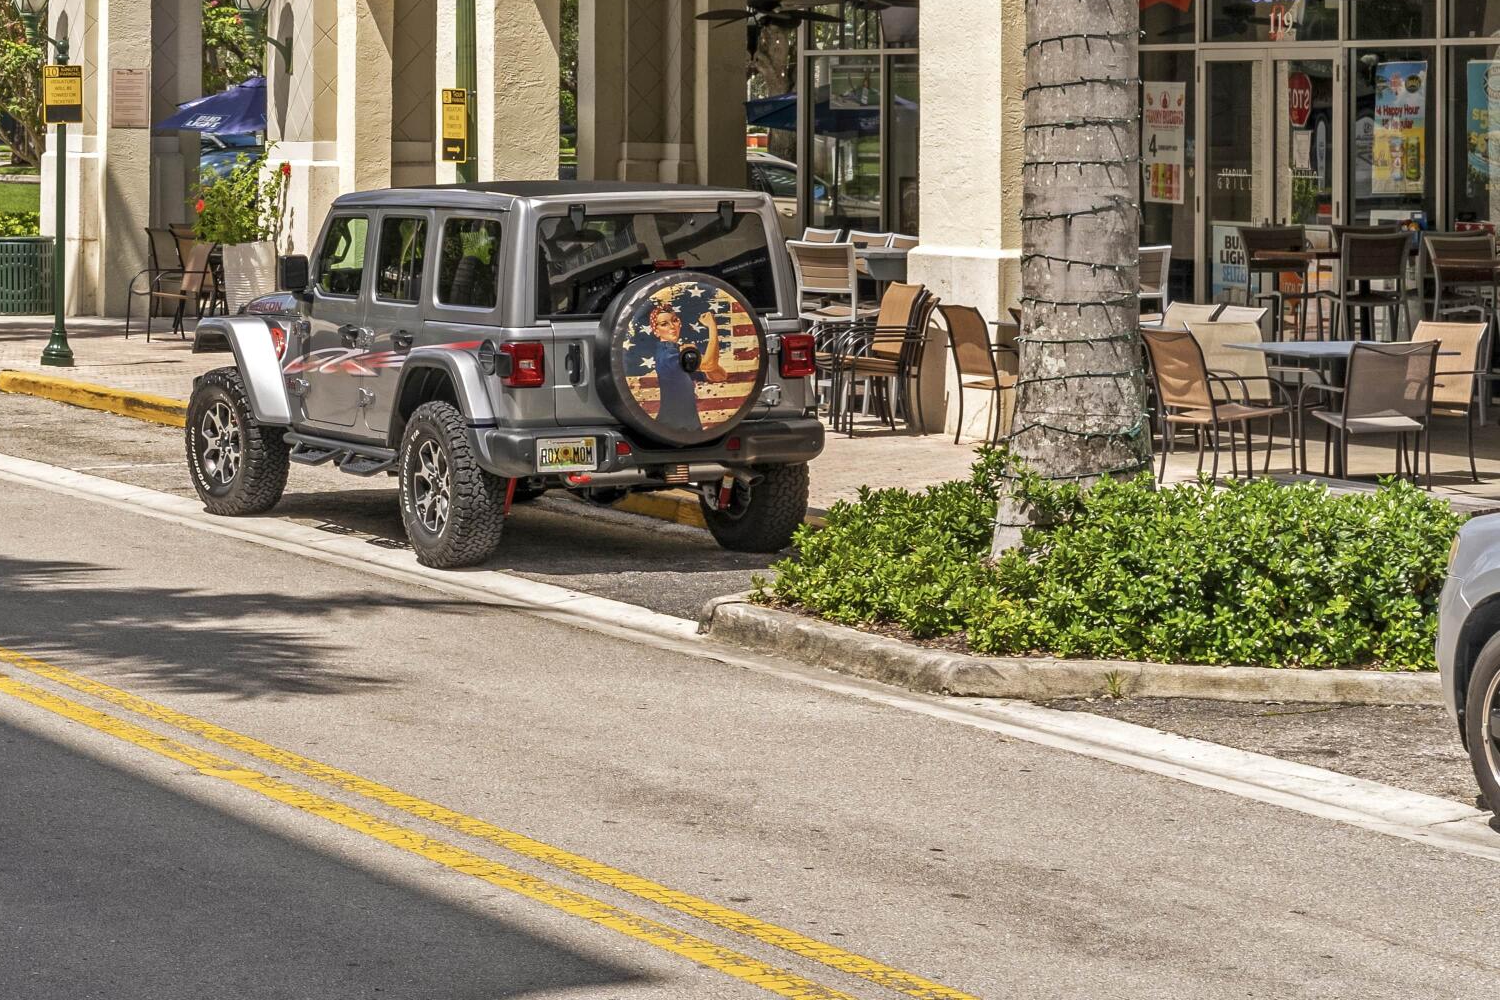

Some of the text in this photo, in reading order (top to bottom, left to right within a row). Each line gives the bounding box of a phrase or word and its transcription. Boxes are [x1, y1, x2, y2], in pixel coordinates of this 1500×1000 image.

[1269, 11, 1293, 34] 119
[46, 68, 58, 77] 10
[1383, 105, 1403, 116] Happy
[1404, 104, 1420, 115] Hour
[184, 120, 221, 128] LIGHT
[1224, 235, 1243, 249] BU
[1220, 250, 1246, 265] LIGH
[541, 446, 593, 464] ROX MOM
